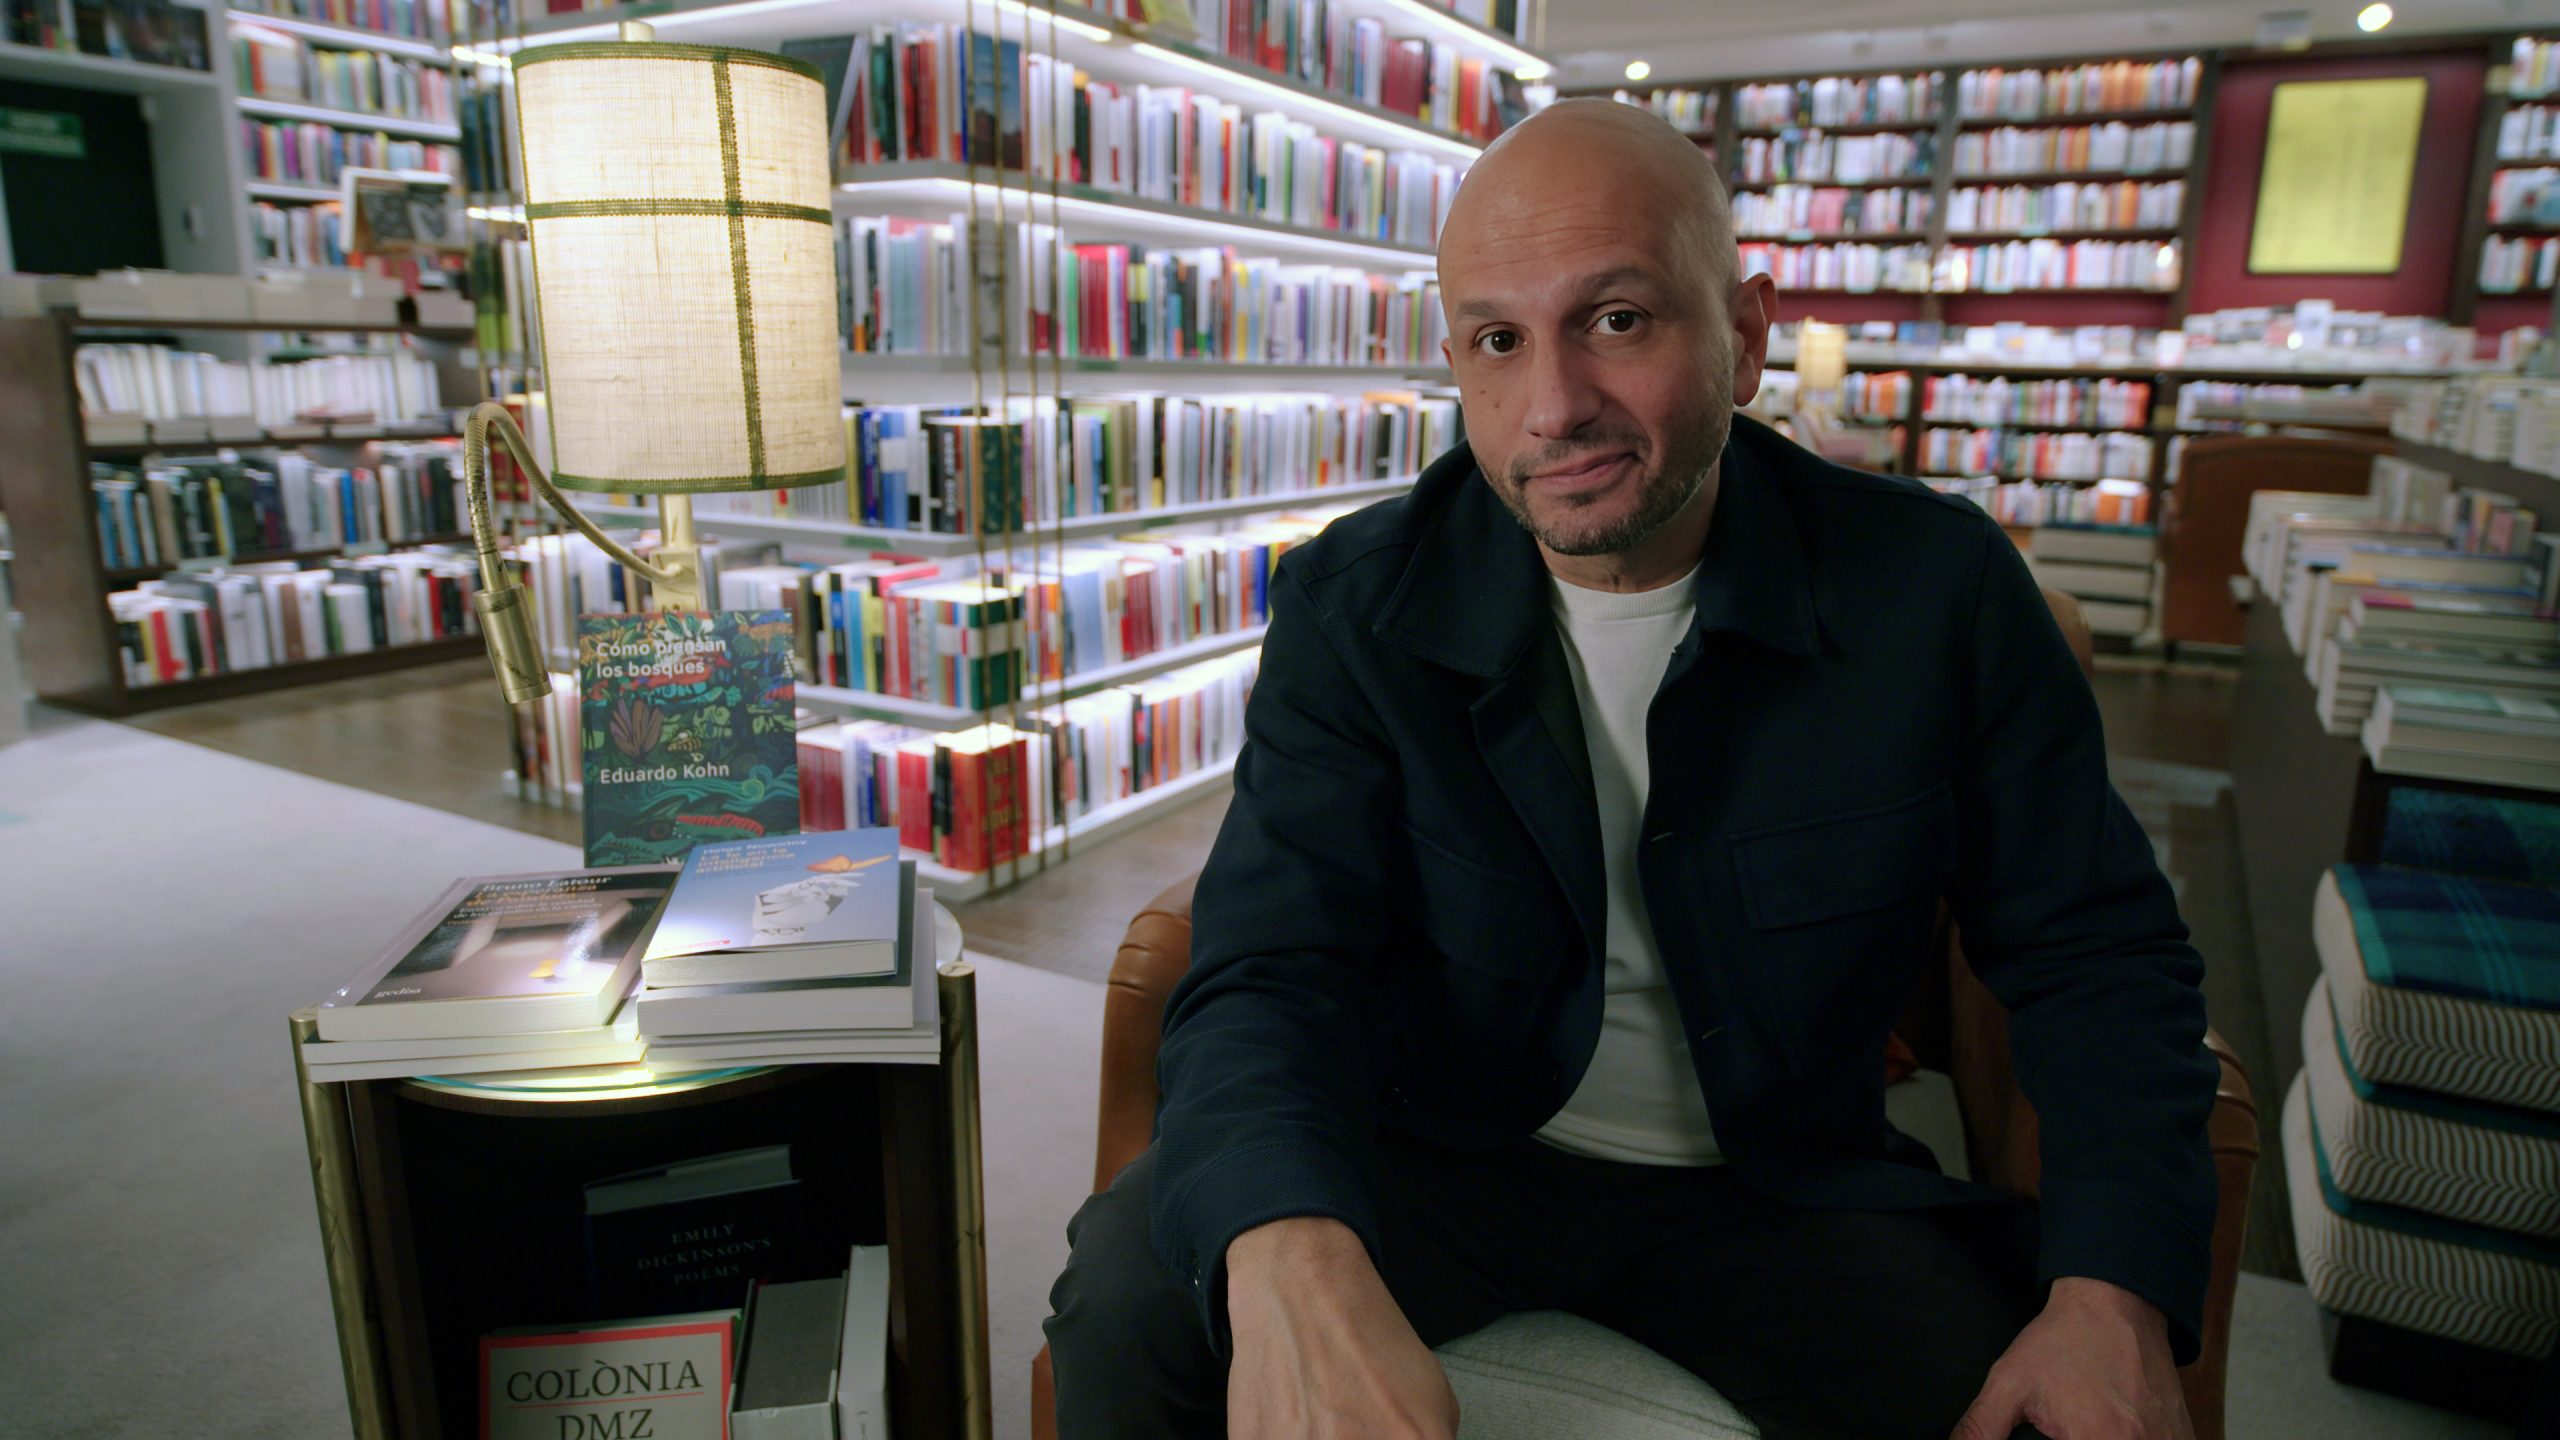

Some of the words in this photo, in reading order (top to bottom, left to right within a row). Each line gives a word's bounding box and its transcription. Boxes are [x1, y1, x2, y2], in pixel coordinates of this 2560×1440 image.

[596, 641, 650, 658] Cómo
[596, 661, 623, 679] los
[628, 660, 705, 679] bosques
[600, 764, 677, 784] Eduardo
[683, 761, 730, 779] Kohn
[482, 883, 542, 892] Bruno
[547, 877, 612, 887] Latour
[672, 1223, 735, 1245] EMILY
[637, 1235, 772, 1270] DICKINSON'S
[674, 1263, 740, 1285] POEMS
[507, 1359, 703, 1402] COLÒNIA
[556, 1408, 654, 1440] DMZ
